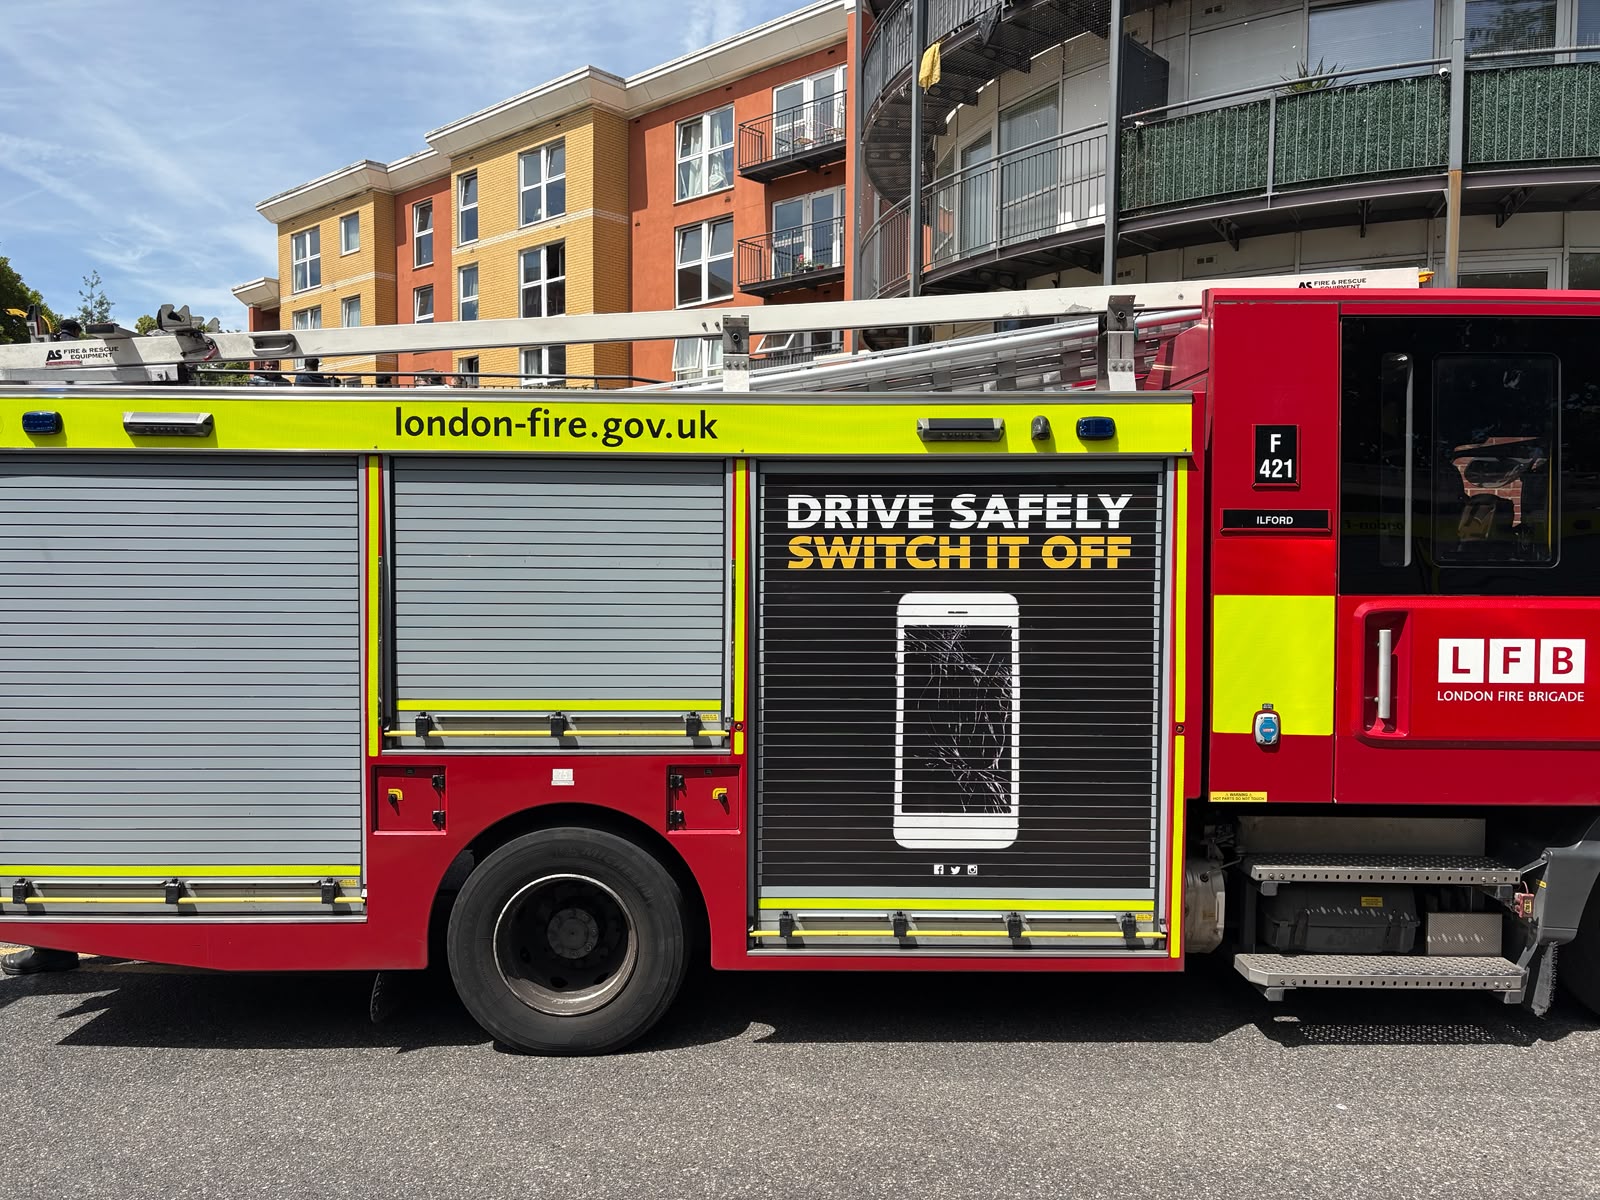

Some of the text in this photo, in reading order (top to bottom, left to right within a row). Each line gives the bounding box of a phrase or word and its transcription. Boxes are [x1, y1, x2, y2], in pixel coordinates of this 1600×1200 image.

[46, 350, 62, 361] AS
[395, 406, 718, 448] london-fire.gov.uk
[1270, 433, 1282, 453] F
[1259, 458, 1293, 478] 421
[787, 493, 1134, 529] DRIVE SAFELY
[1256, 515, 1294, 525] ILFORD
[787, 535, 1132, 569] SWITCH IT OFF
[1451, 646, 1574, 675] LFB
[1437, 690, 1585, 702] LONDON FIRE BRIGADE
